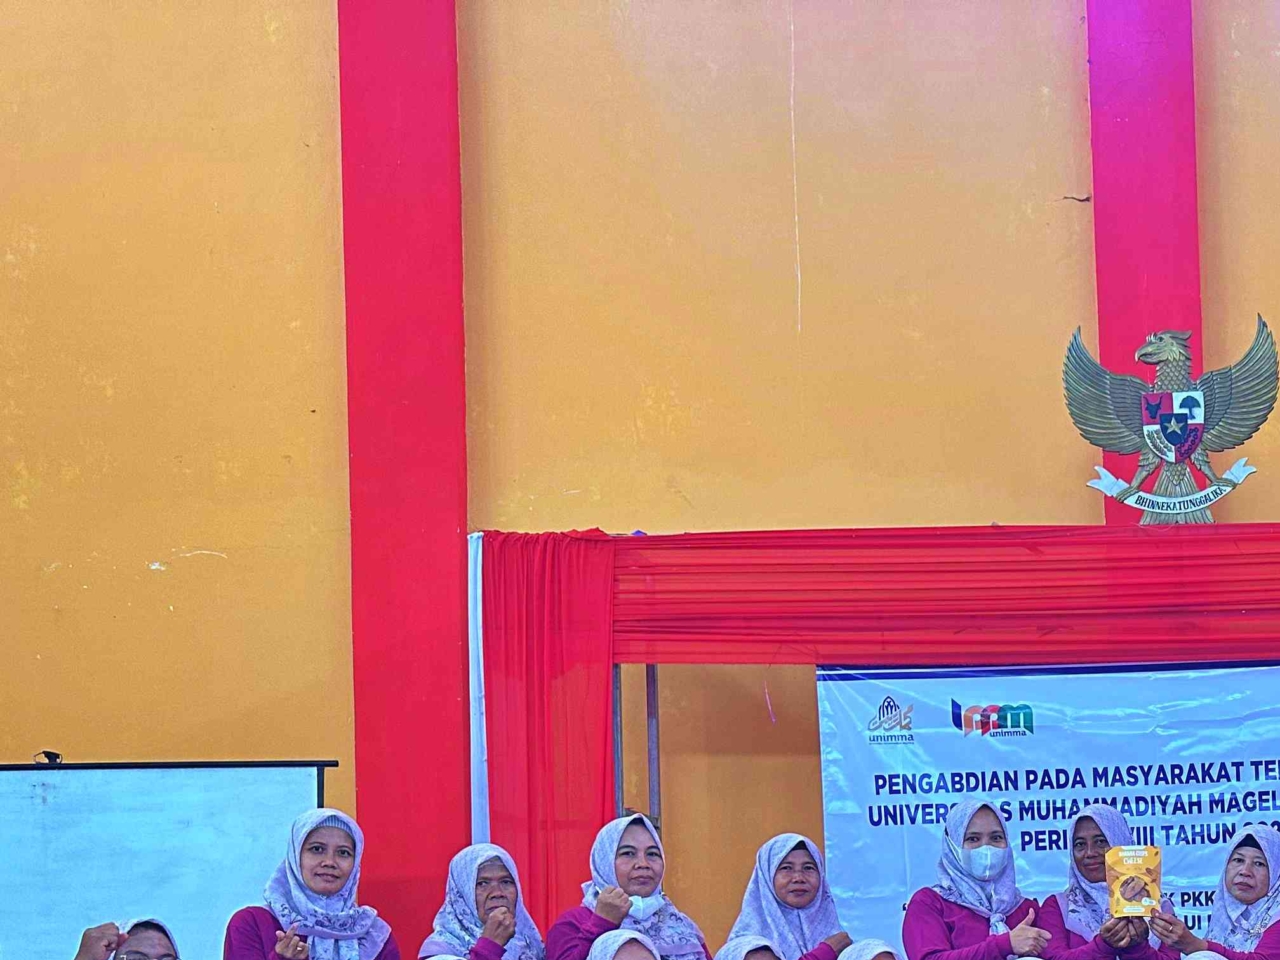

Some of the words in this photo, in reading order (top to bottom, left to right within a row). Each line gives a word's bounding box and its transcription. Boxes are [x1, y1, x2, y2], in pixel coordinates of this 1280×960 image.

[869, 734, 914, 743] unimma
[990, 730, 1027, 738] unimma
[875, 770, 1018, 795] PENGABDIAN
[1026, 768, 1086, 790] PADA
[1093, 761, 1244, 787] MASYARAKAT
[868, 800, 1013, 827] UNIVERS
[1161, 820, 1237, 846] TAHUN
